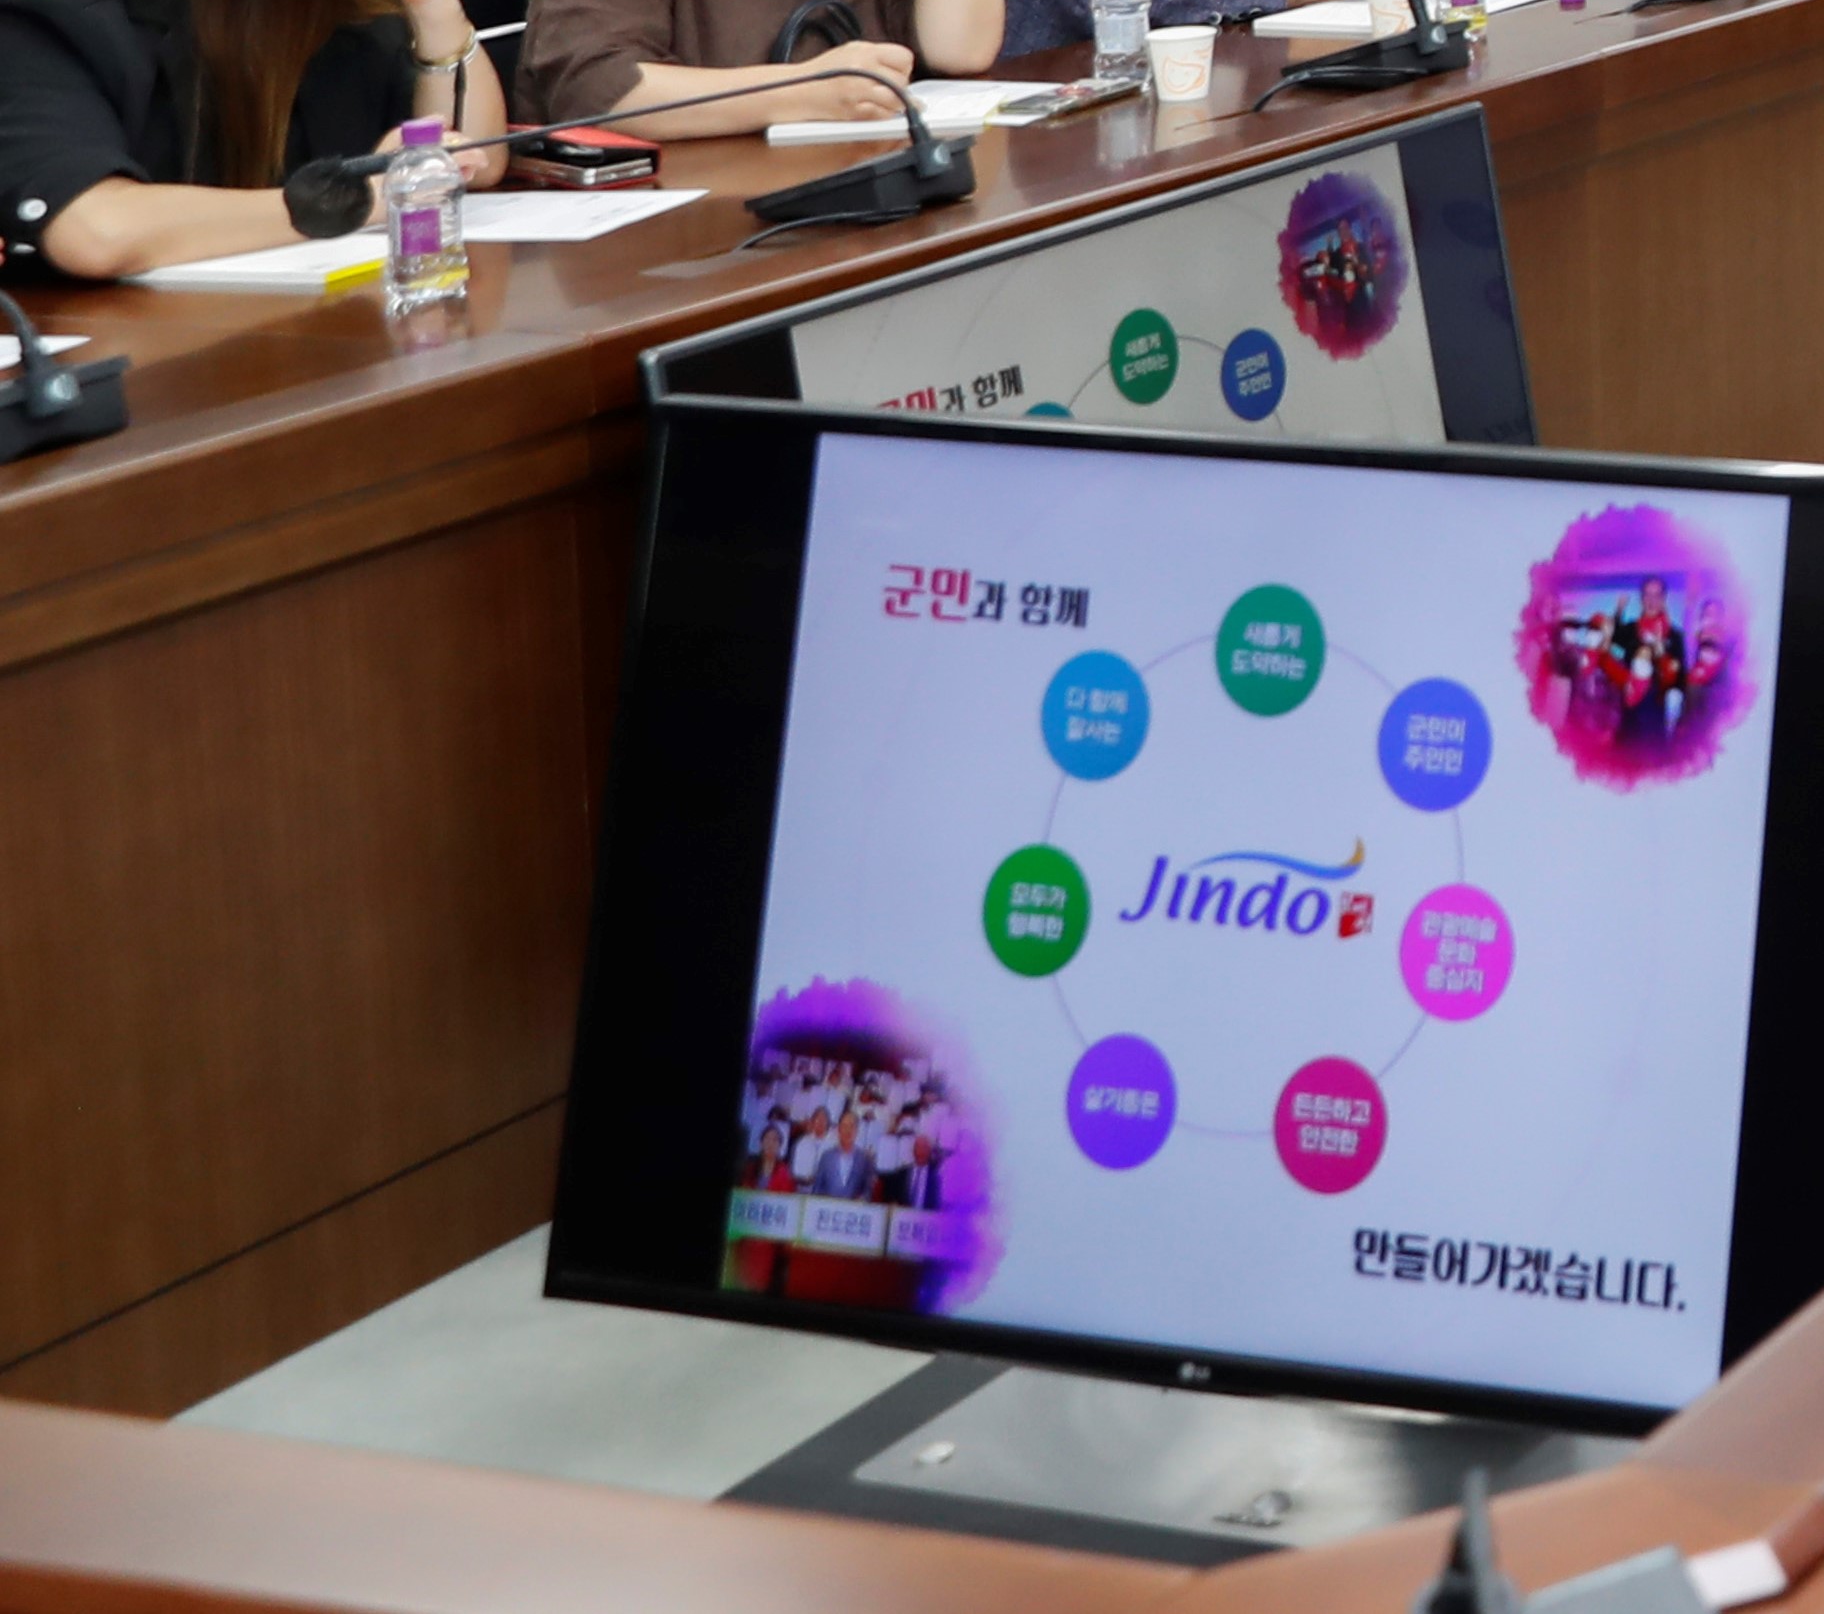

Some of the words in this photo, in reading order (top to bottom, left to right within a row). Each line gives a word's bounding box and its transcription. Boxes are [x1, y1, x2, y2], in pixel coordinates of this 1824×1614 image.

[972, 364, 1024, 408] 함께
[884, 564, 1006, 622] 군민과
[1020, 583, 1090, 628] 함께
[1118, 855, 1331, 935] Jindo
[1353, 1227, 1686, 1313] 만들어가겠습니다.
